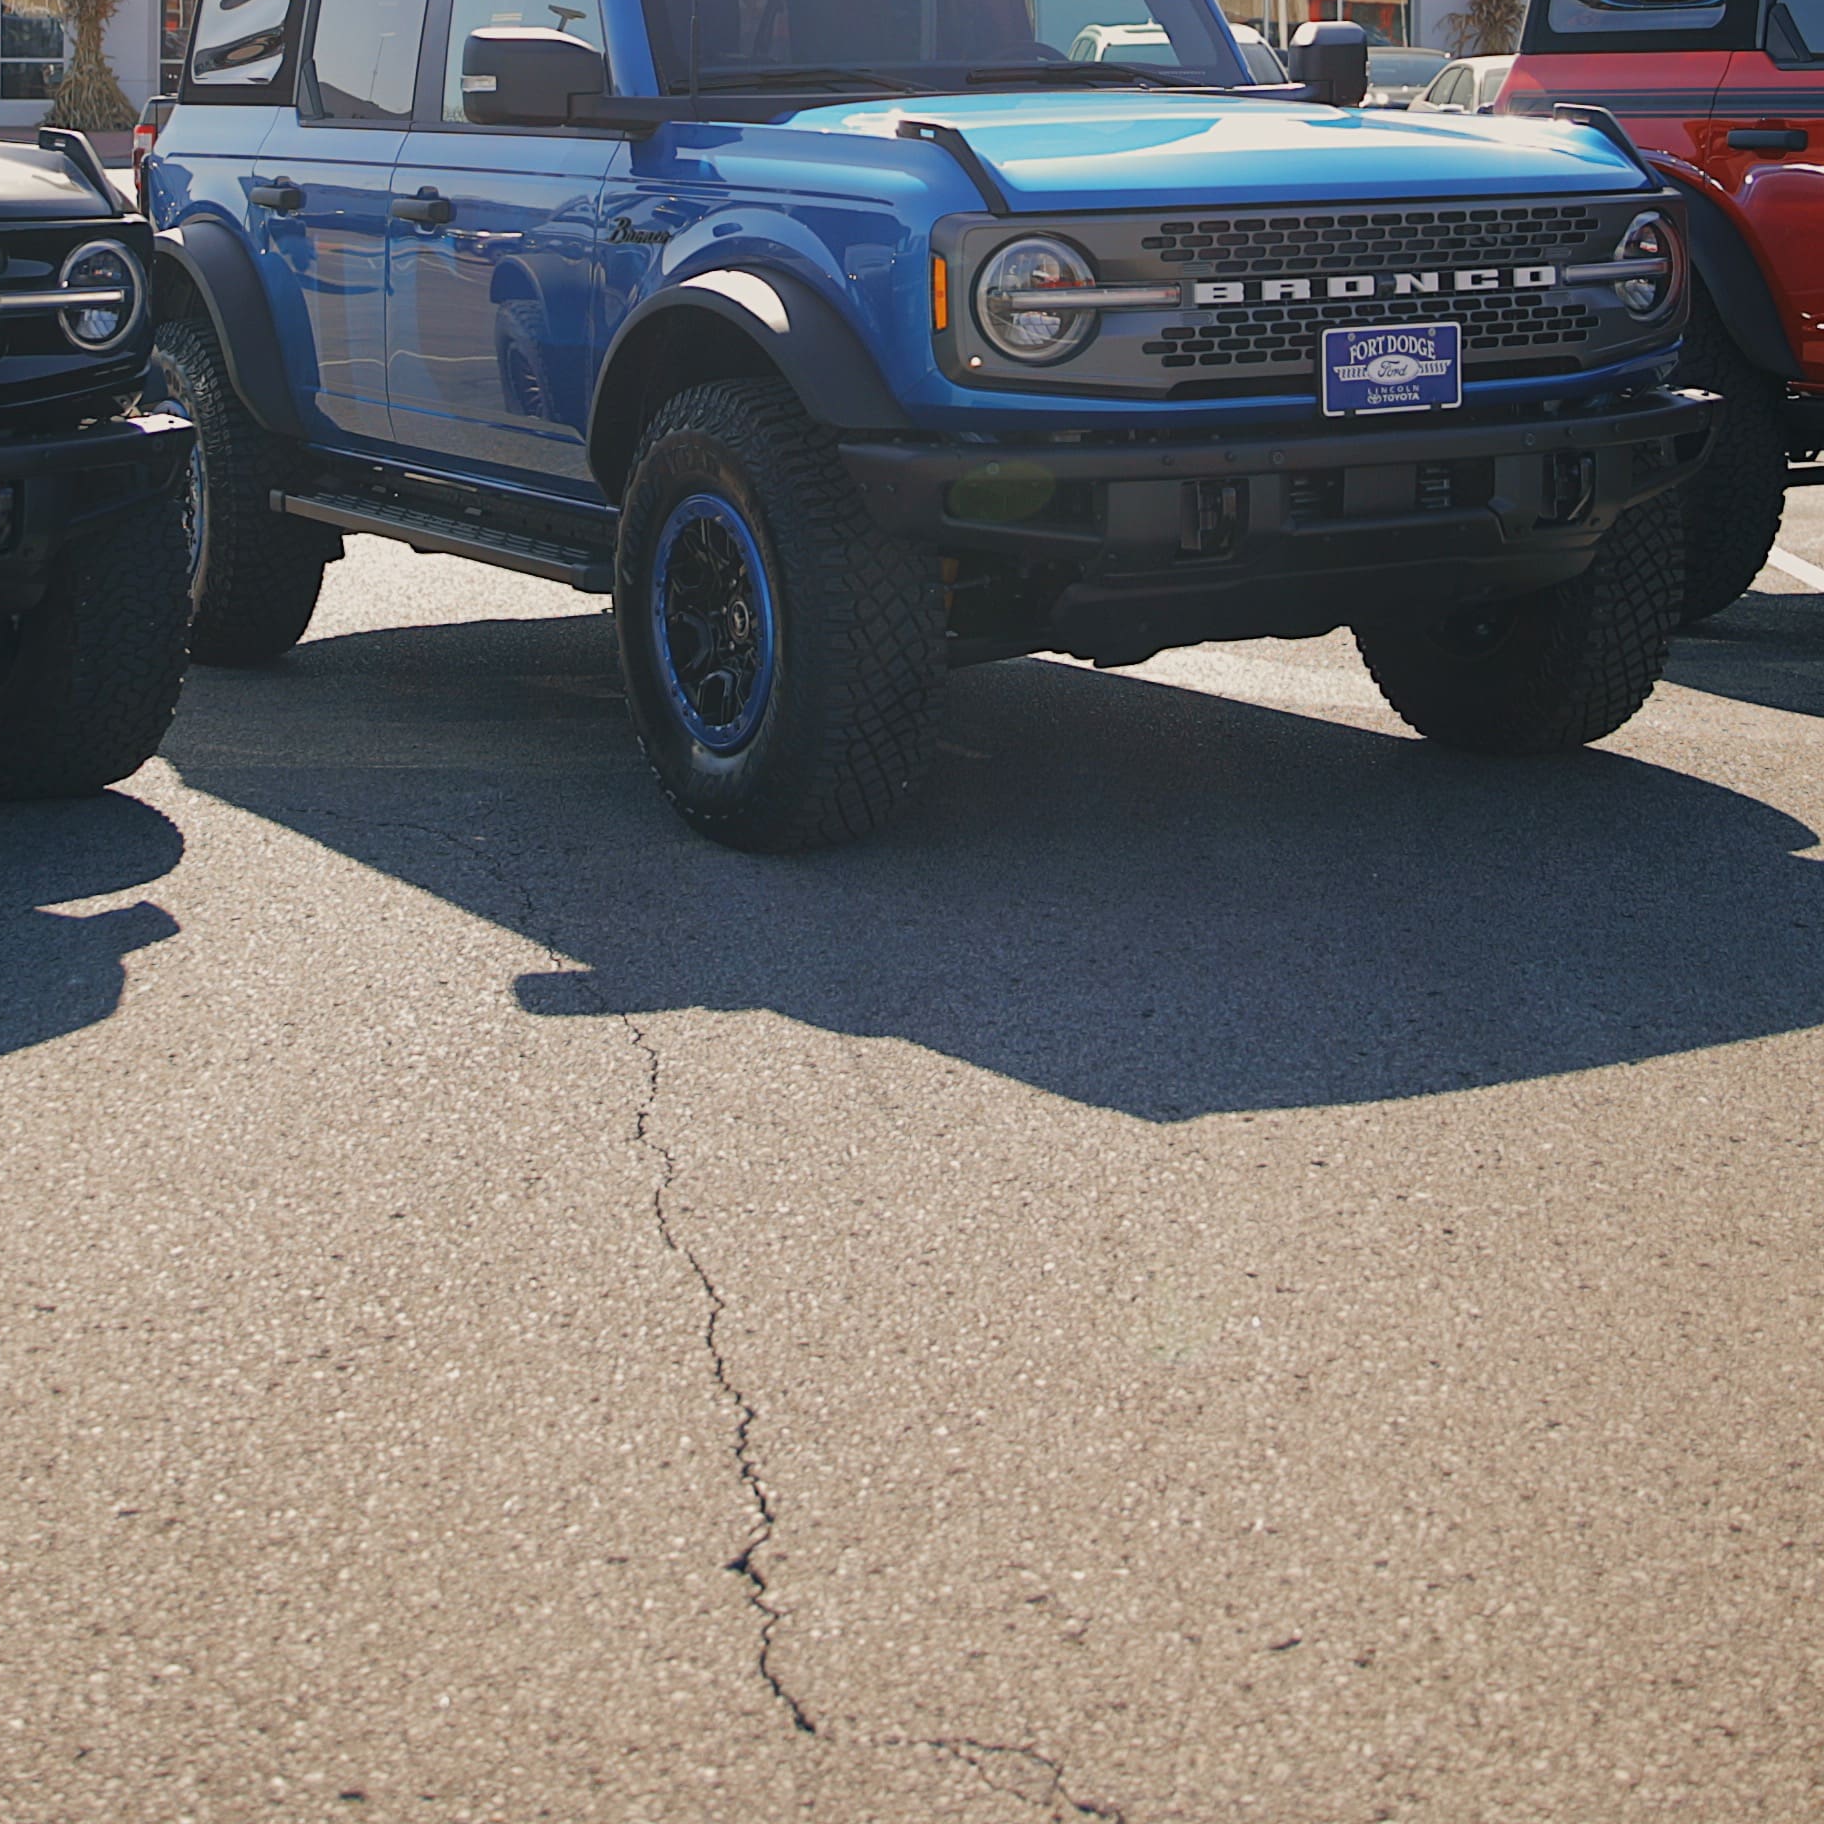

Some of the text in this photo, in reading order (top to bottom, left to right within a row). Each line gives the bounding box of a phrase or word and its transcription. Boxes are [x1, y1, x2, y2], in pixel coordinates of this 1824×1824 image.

[1194, 265, 1557, 305] BRONCO
[1349, 334, 1437, 365] FORT DODGE
[1377, 360, 1408, 378] Ford
[1367, 384, 1420, 394] LINCOLN
[1382, 392, 1420, 402] TOYOTA
